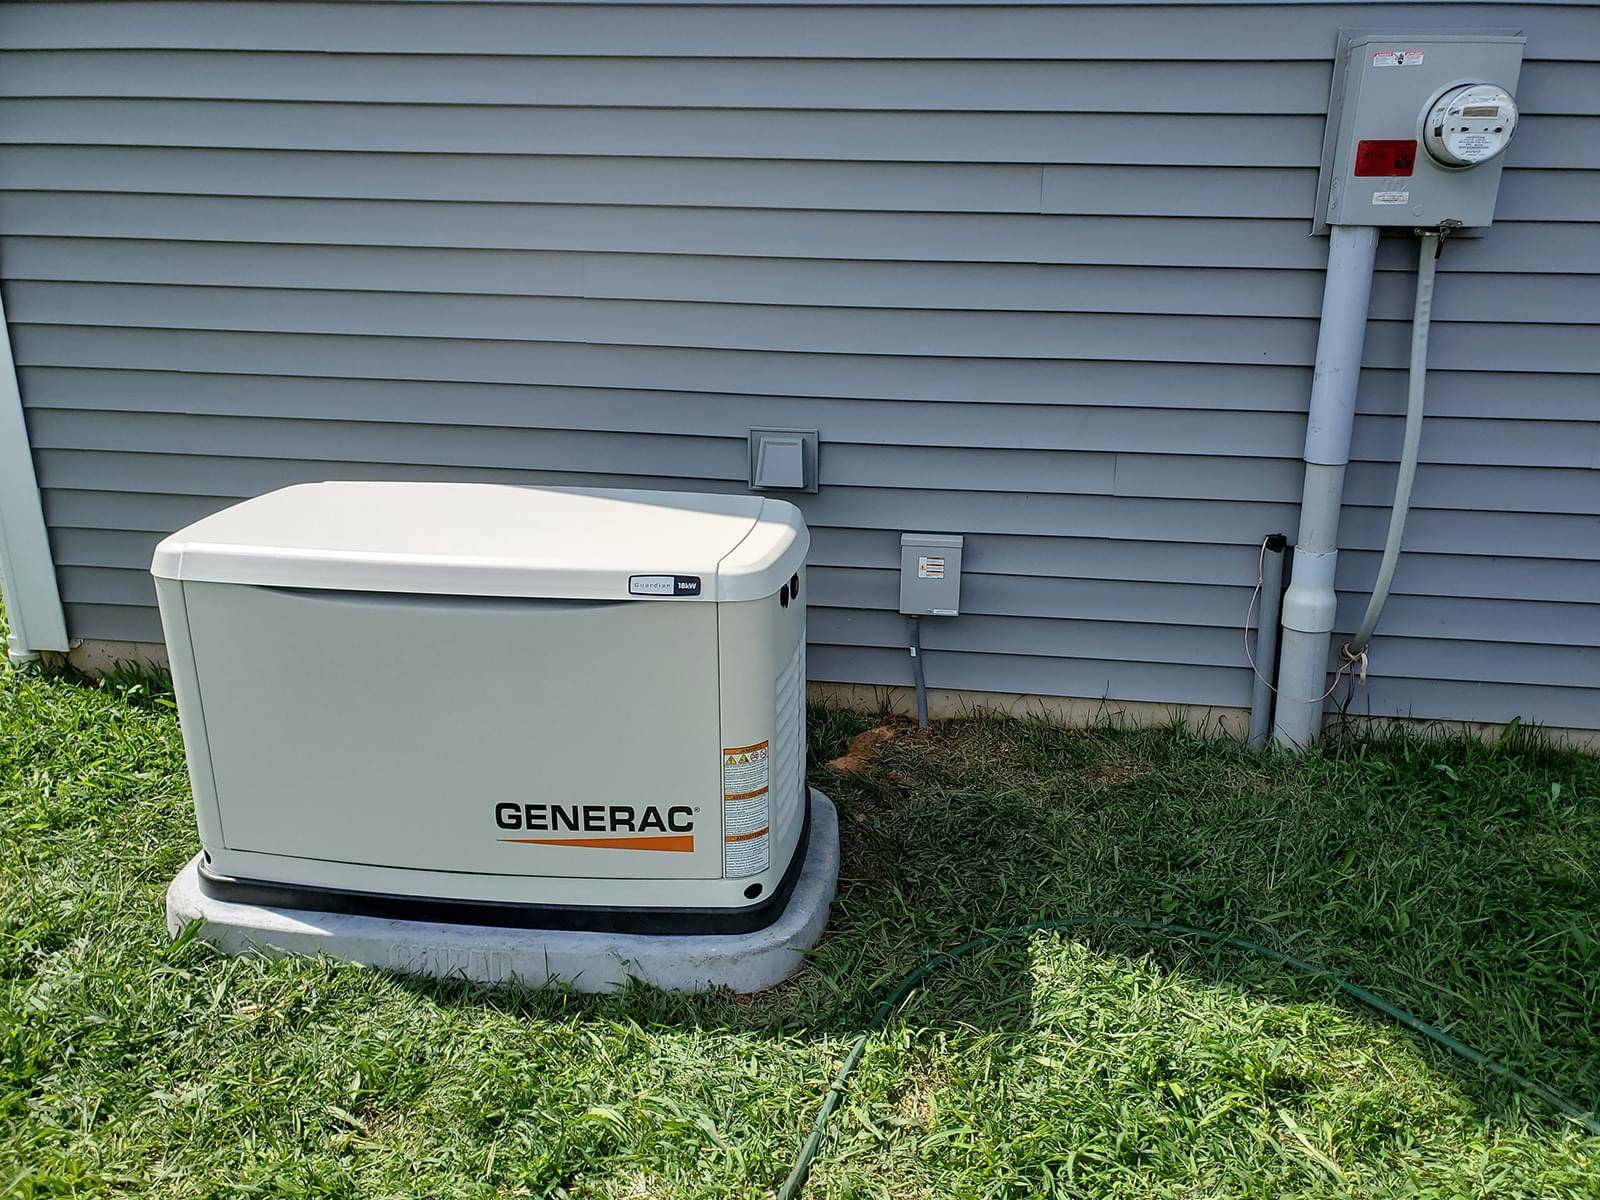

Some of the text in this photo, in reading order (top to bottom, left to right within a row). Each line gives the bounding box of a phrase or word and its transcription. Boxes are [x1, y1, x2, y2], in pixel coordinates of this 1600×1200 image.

[634, 581, 697, 590] Guardian 18kW
[495, 802, 694, 832] GENERAC
